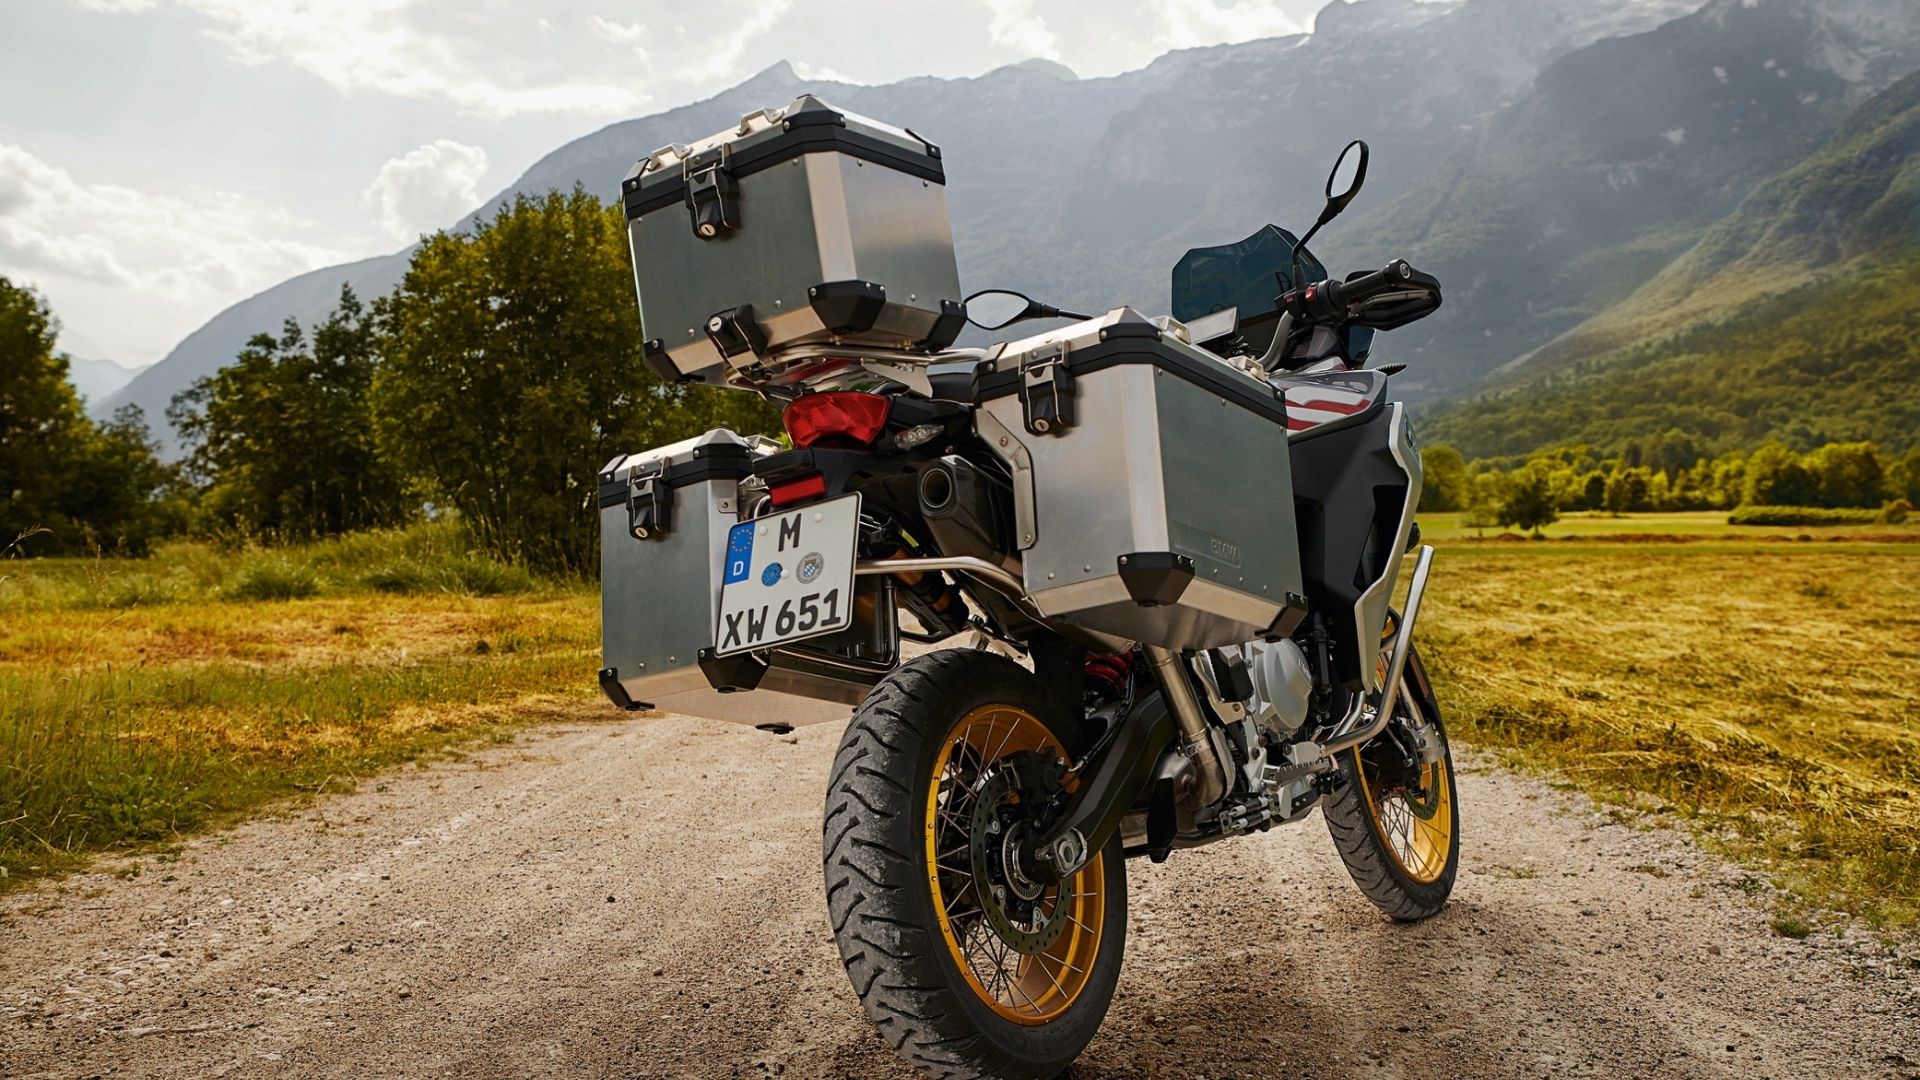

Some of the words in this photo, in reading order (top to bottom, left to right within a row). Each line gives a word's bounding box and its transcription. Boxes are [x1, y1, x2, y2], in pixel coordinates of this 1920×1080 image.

[778, 513, 801, 552] M
[733, 561, 744, 576] D
[722, 605, 769, 649] XW
[775, 588, 841, 636] 651
